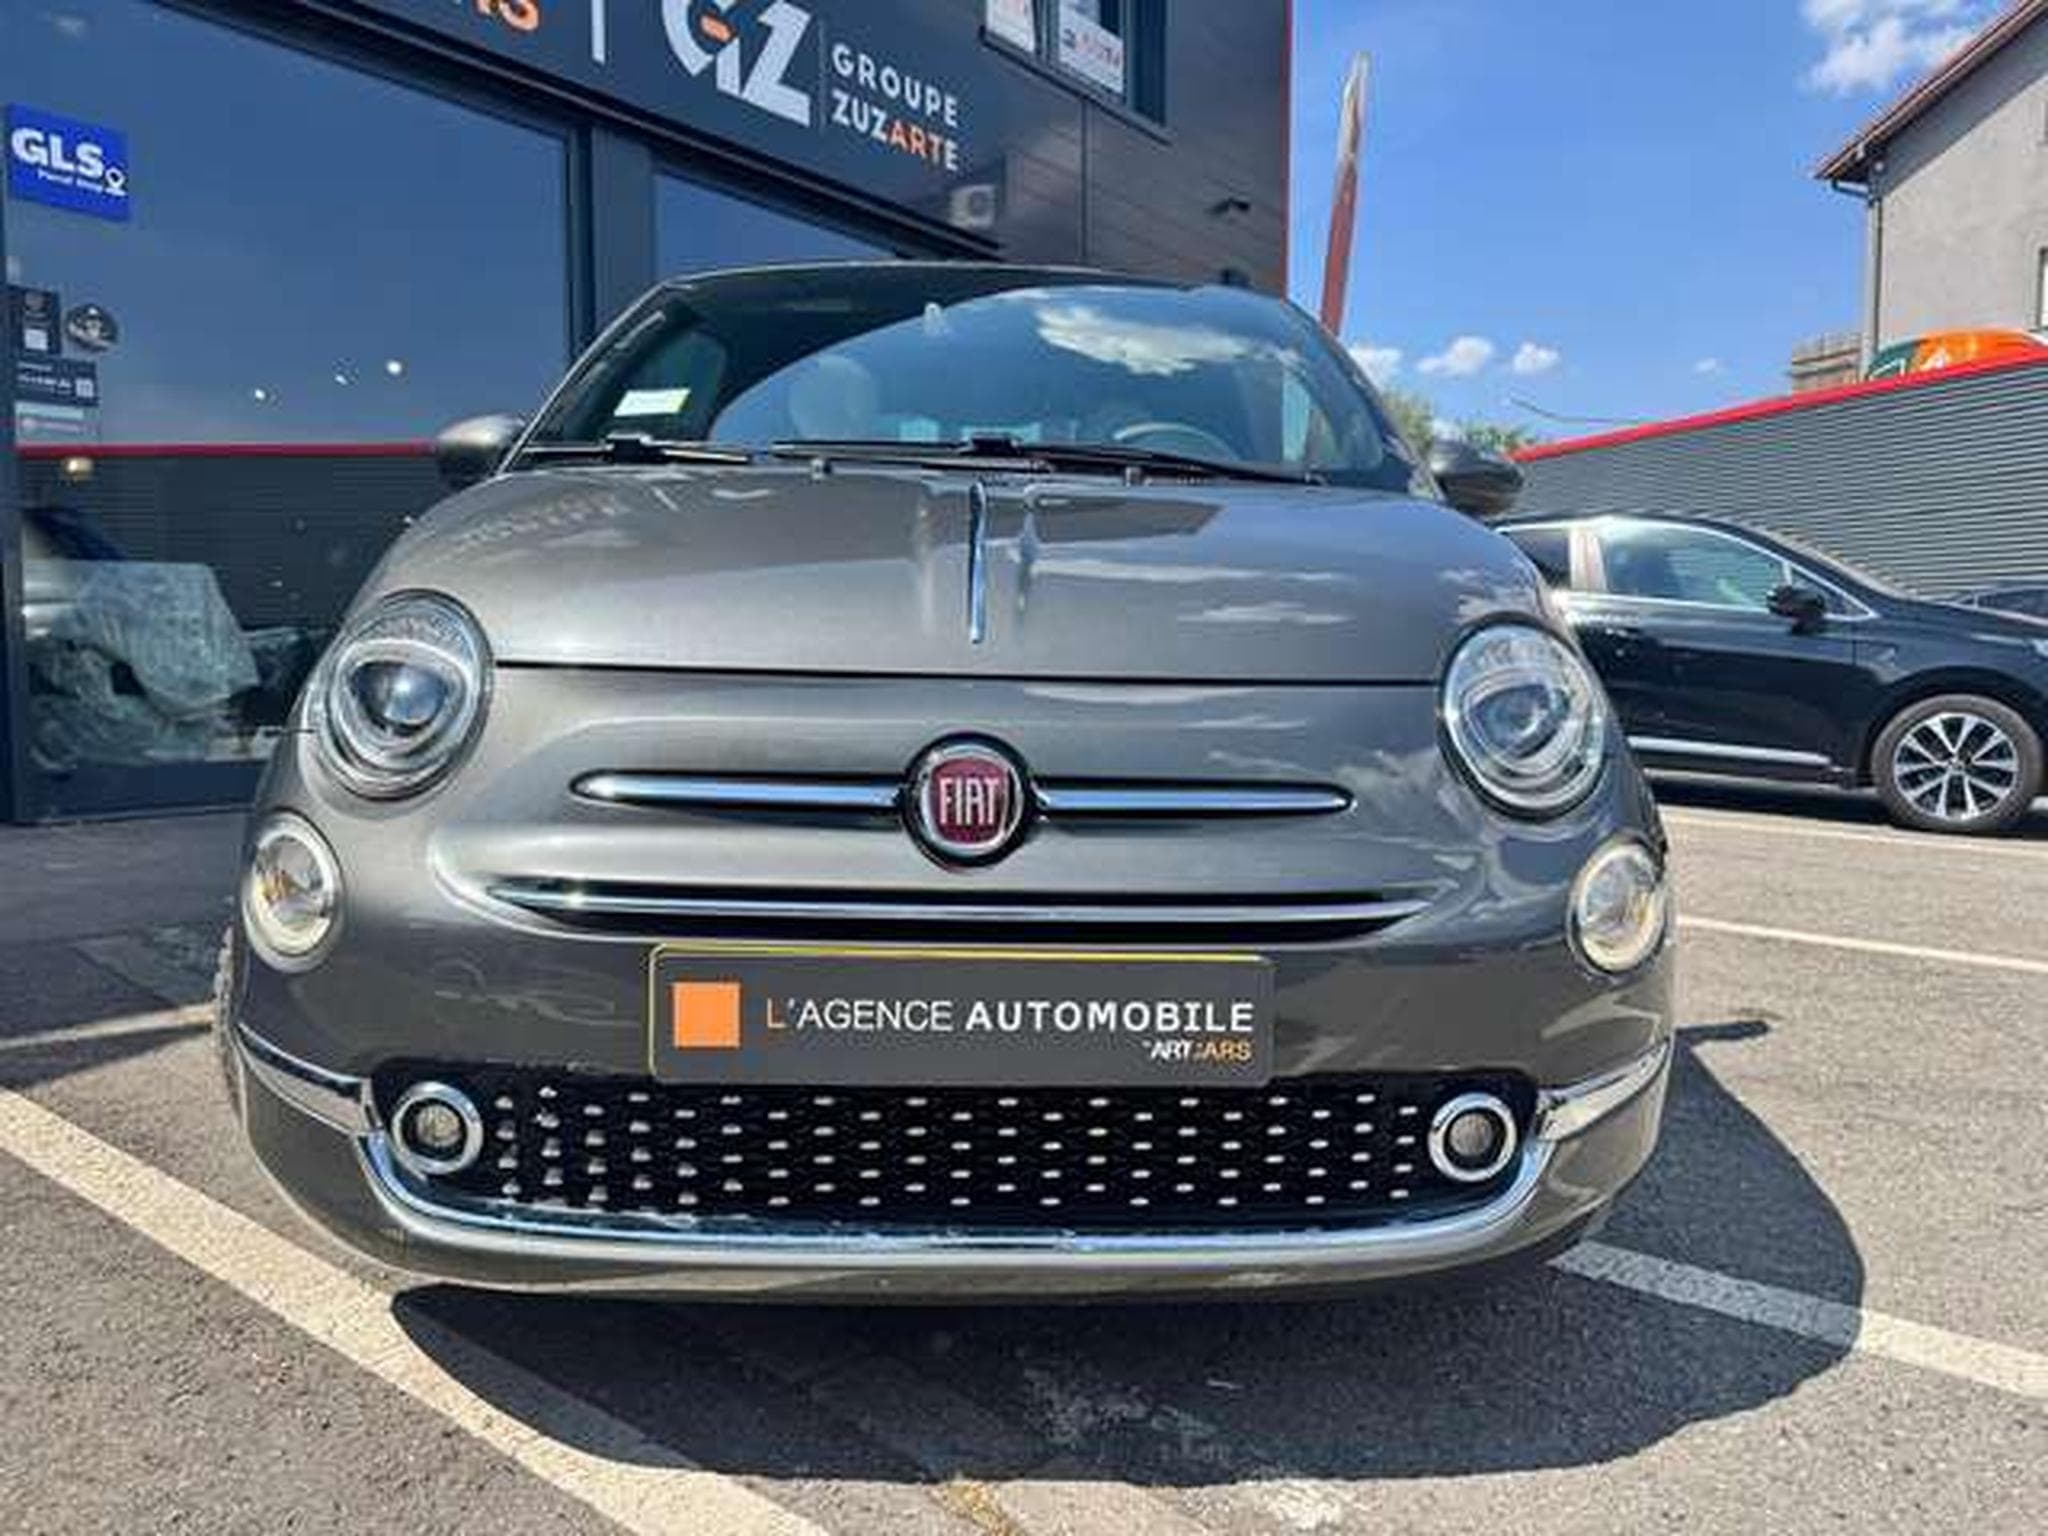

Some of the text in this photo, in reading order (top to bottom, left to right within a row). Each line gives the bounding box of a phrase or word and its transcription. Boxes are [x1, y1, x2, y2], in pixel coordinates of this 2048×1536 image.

[832, 42, 958, 128] GROUPE
[11, 127, 105, 178] GLS
[832, 87, 958, 171] ZUZARTE
[938, 777, 1000, 825] FIAT
[765, 998, 1254, 1032] L'AGENCE AUTOMOBILE
